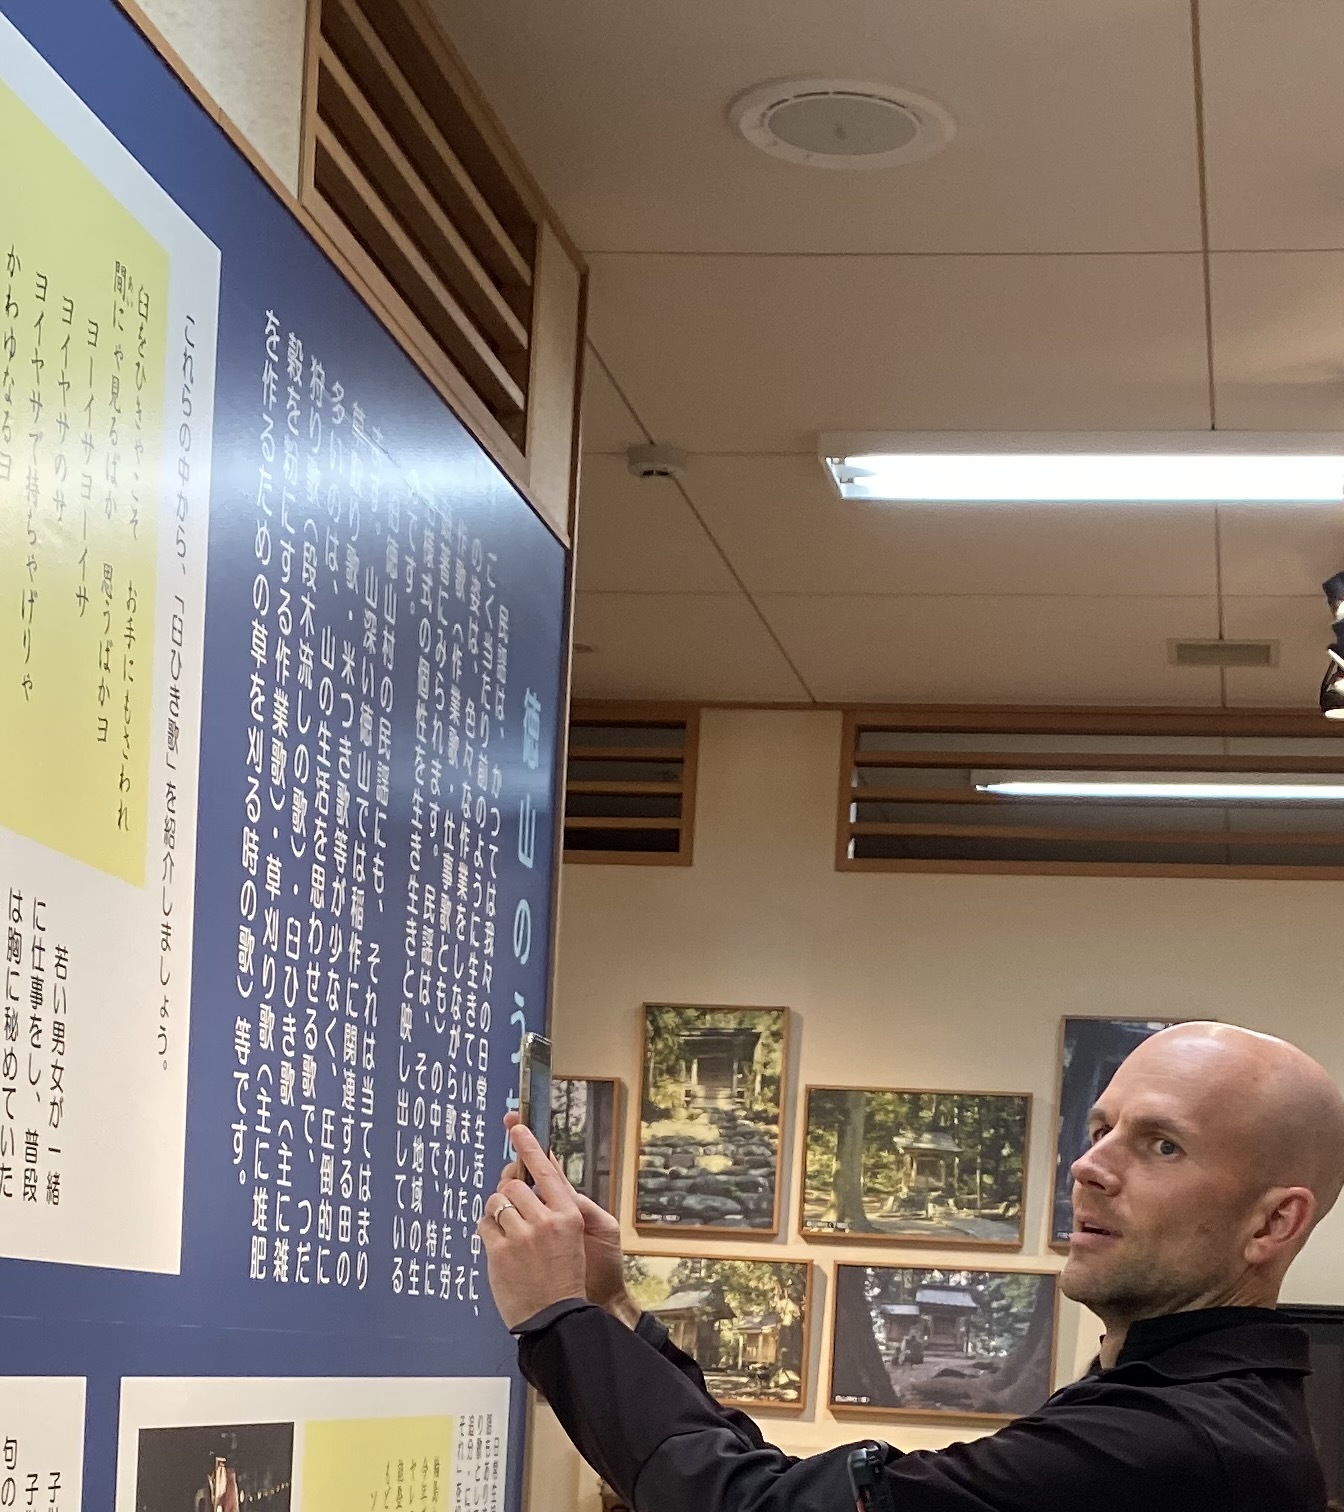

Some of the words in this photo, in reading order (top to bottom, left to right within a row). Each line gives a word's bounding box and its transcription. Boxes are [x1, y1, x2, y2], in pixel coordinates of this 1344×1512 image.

[21, 896, 46, 1203] に仕事をし、普段
[45, 943, 69, 1206] 若い男女が一緒
